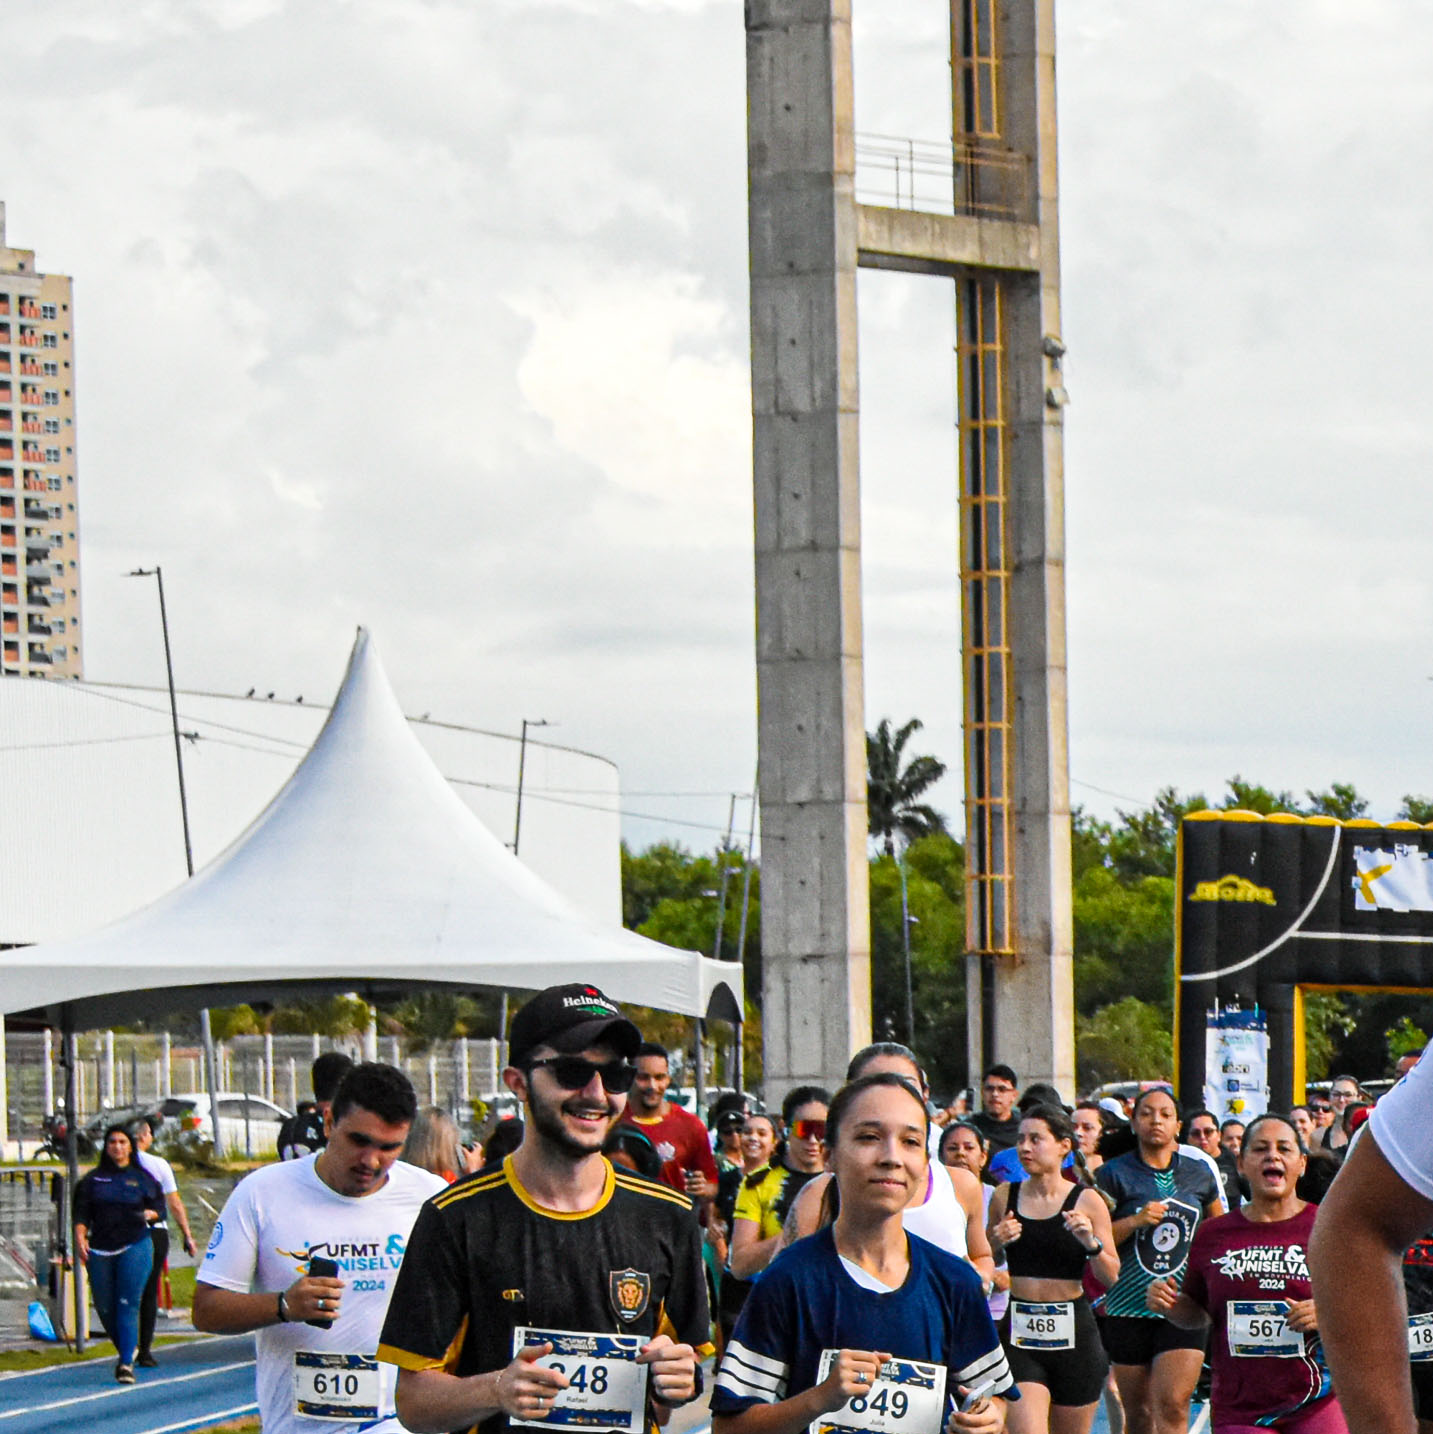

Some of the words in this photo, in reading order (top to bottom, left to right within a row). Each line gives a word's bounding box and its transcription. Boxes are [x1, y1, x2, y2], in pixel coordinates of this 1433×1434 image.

[326, 1244, 380, 1257] UFMT
[1241, 1250, 1283, 1260] UFMT
[1285, 1245, 1306, 1263] &
[1236, 1260, 1310, 1276] UNISELVA
[353, 1279, 385, 1291] 2024
[1259, 1279, 1285, 1289] 2024
[1026, 1318, 1055, 1332] 468
[1249, 1320, 1285, 1337] 567
[314, 1373, 358, 1395] 610
